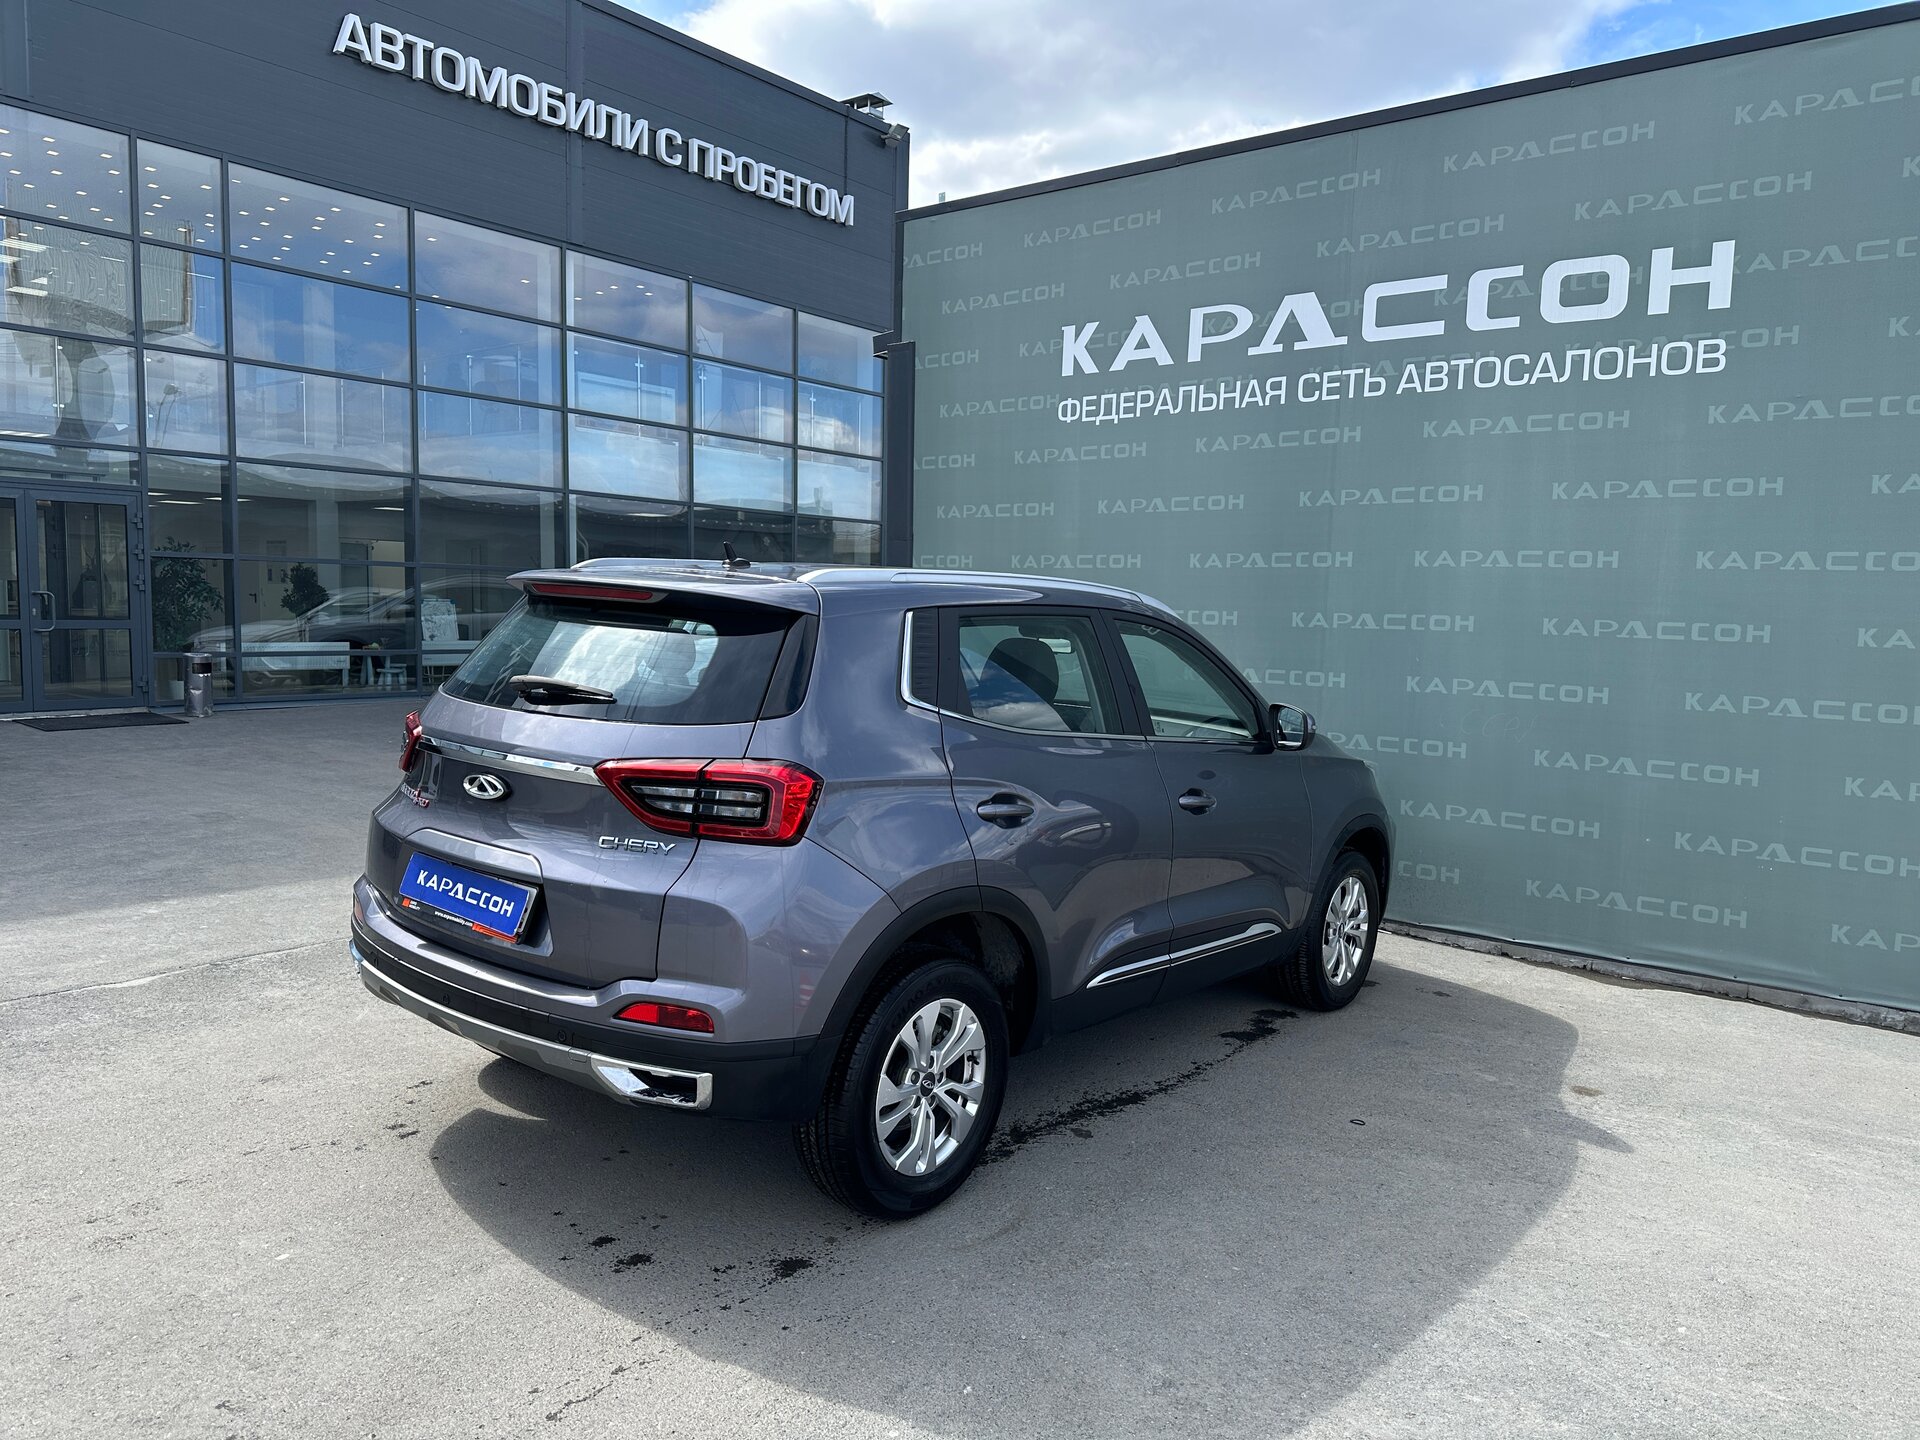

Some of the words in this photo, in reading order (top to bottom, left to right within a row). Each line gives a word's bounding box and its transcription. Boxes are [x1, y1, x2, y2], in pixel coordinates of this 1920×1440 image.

[333, 12, 649, 157] АВТОМОБИЛИ
[655, 127, 683, 168] С
[688, 138, 855, 227] ПРОБЕГОМ
[1057, 376, 1288, 426] ФЕДЕРАЛЬНАЯ
[1297, 368, 1387, 403] СЕТЬ
[1396, 339, 1728, 396] АВТОСАЛОНОВ
[598, 836, 677, 856] CHERY
